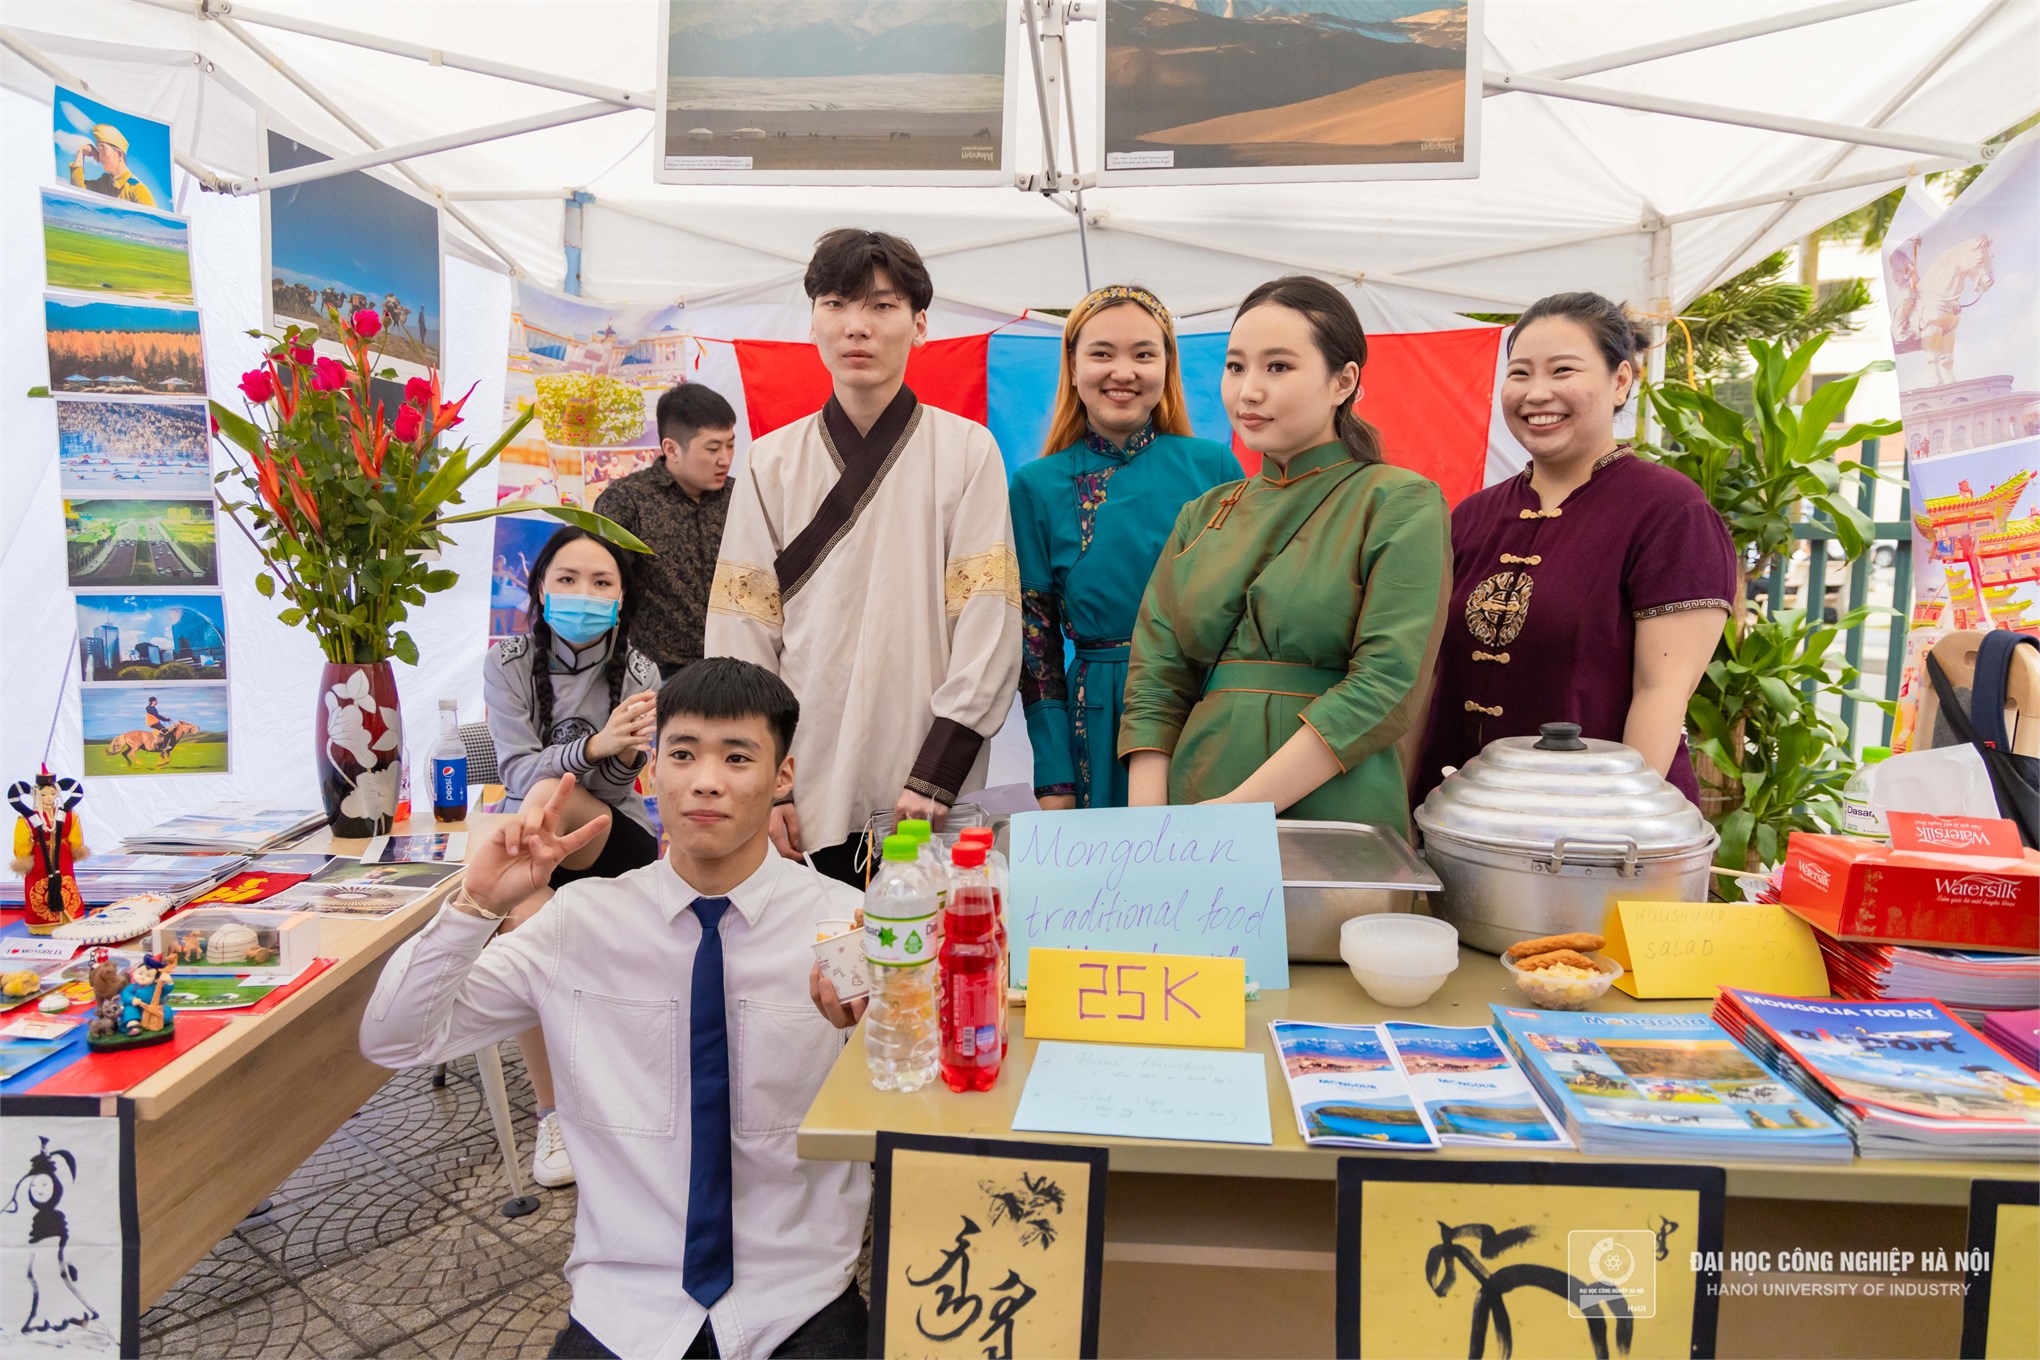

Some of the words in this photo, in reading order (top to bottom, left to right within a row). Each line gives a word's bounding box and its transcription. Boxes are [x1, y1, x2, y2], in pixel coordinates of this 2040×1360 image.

[444, 778, 454, 801] pepsi
[1916, 826, 1990, 845] Watersilk
[1018, 813, 1241, 890] Mongolian
[1935, 878, 2017, 899] Watersilk
[1026, 887, 1189, 938] traditional
[1197, 886, 1275, 939] food
[1079, 963, 1201, 1021] 25K
[1742, 995, 1859, 1016] MONGOLIA
[1860, 1008, 1936, 1019] TODAY
[1583, 1015, 1709, 1027] Mongolia
